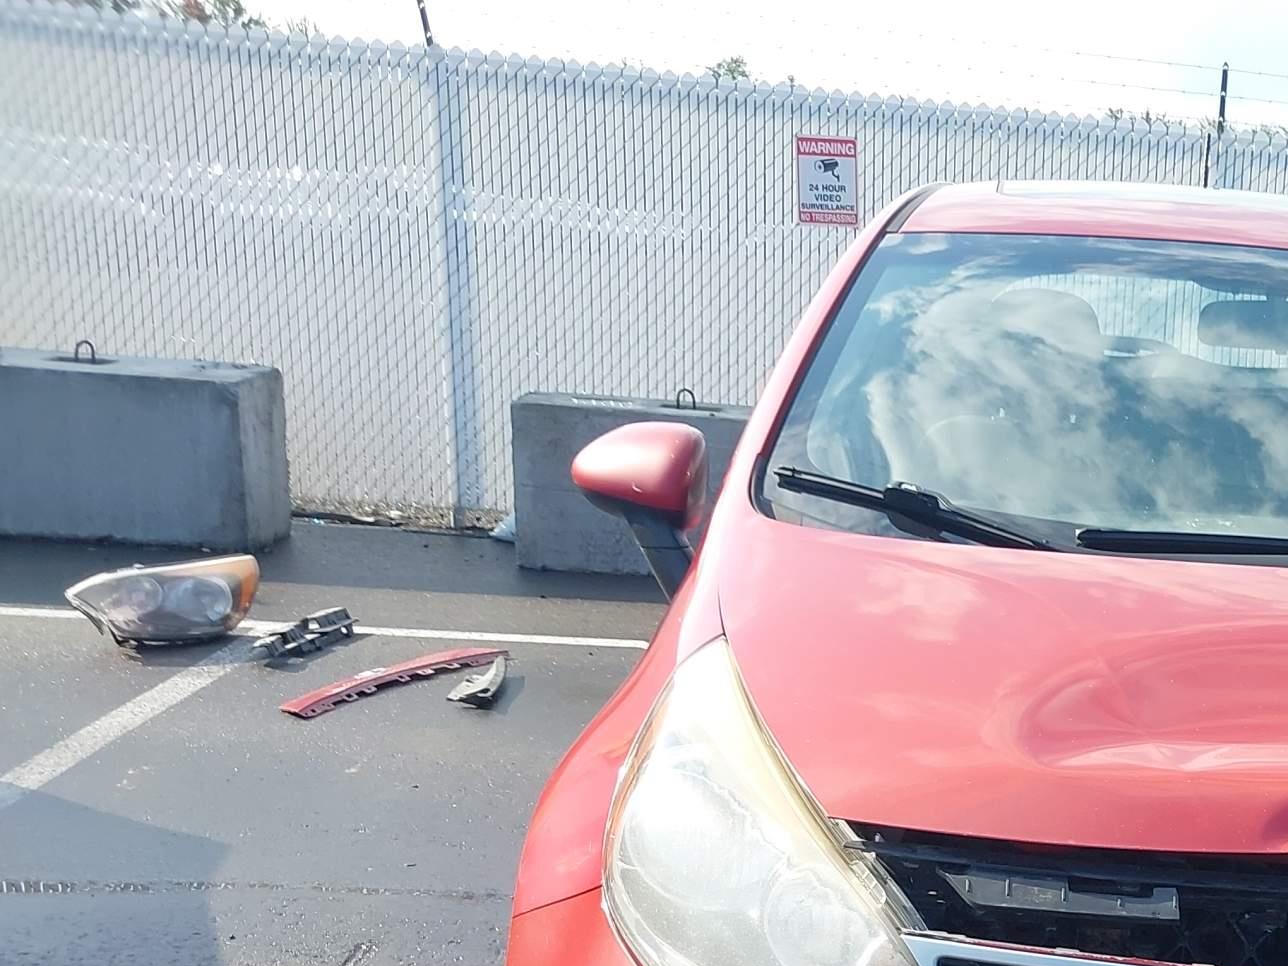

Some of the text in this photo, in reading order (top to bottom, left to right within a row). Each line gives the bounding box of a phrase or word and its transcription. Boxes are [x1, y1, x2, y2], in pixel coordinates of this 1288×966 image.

[798, 141, 855, 155] WARNING
[809, 184, 846, 193] 24 HOUR
[814, 194, 842, 202] VIDEO
[801, 202, 855, 211] SURVEILLANCE
[811, 213, 856, 223] TRESPASSING
